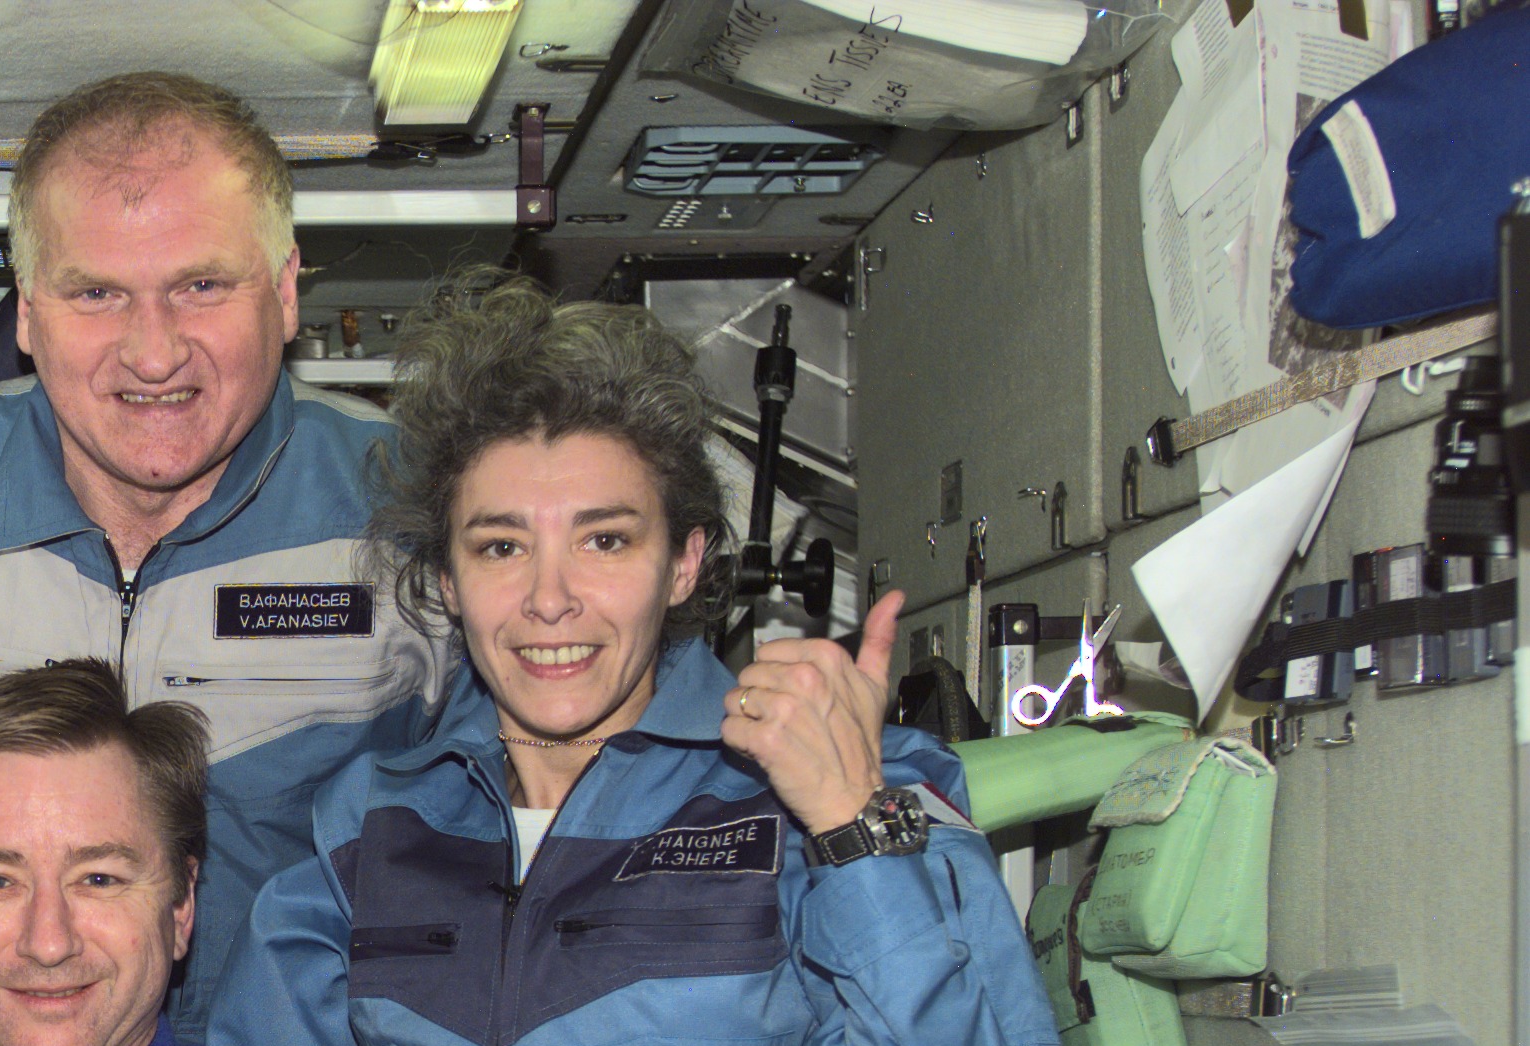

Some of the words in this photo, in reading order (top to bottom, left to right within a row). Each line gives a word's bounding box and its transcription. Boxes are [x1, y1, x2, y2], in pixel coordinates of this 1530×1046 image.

[239, 592, 351, 609] В.АФАНАСЬЕВ
[239, 612, 350, 630] V.AFANASIEV
[651, 849, 739, 867] К.ЭНЕРЕ
